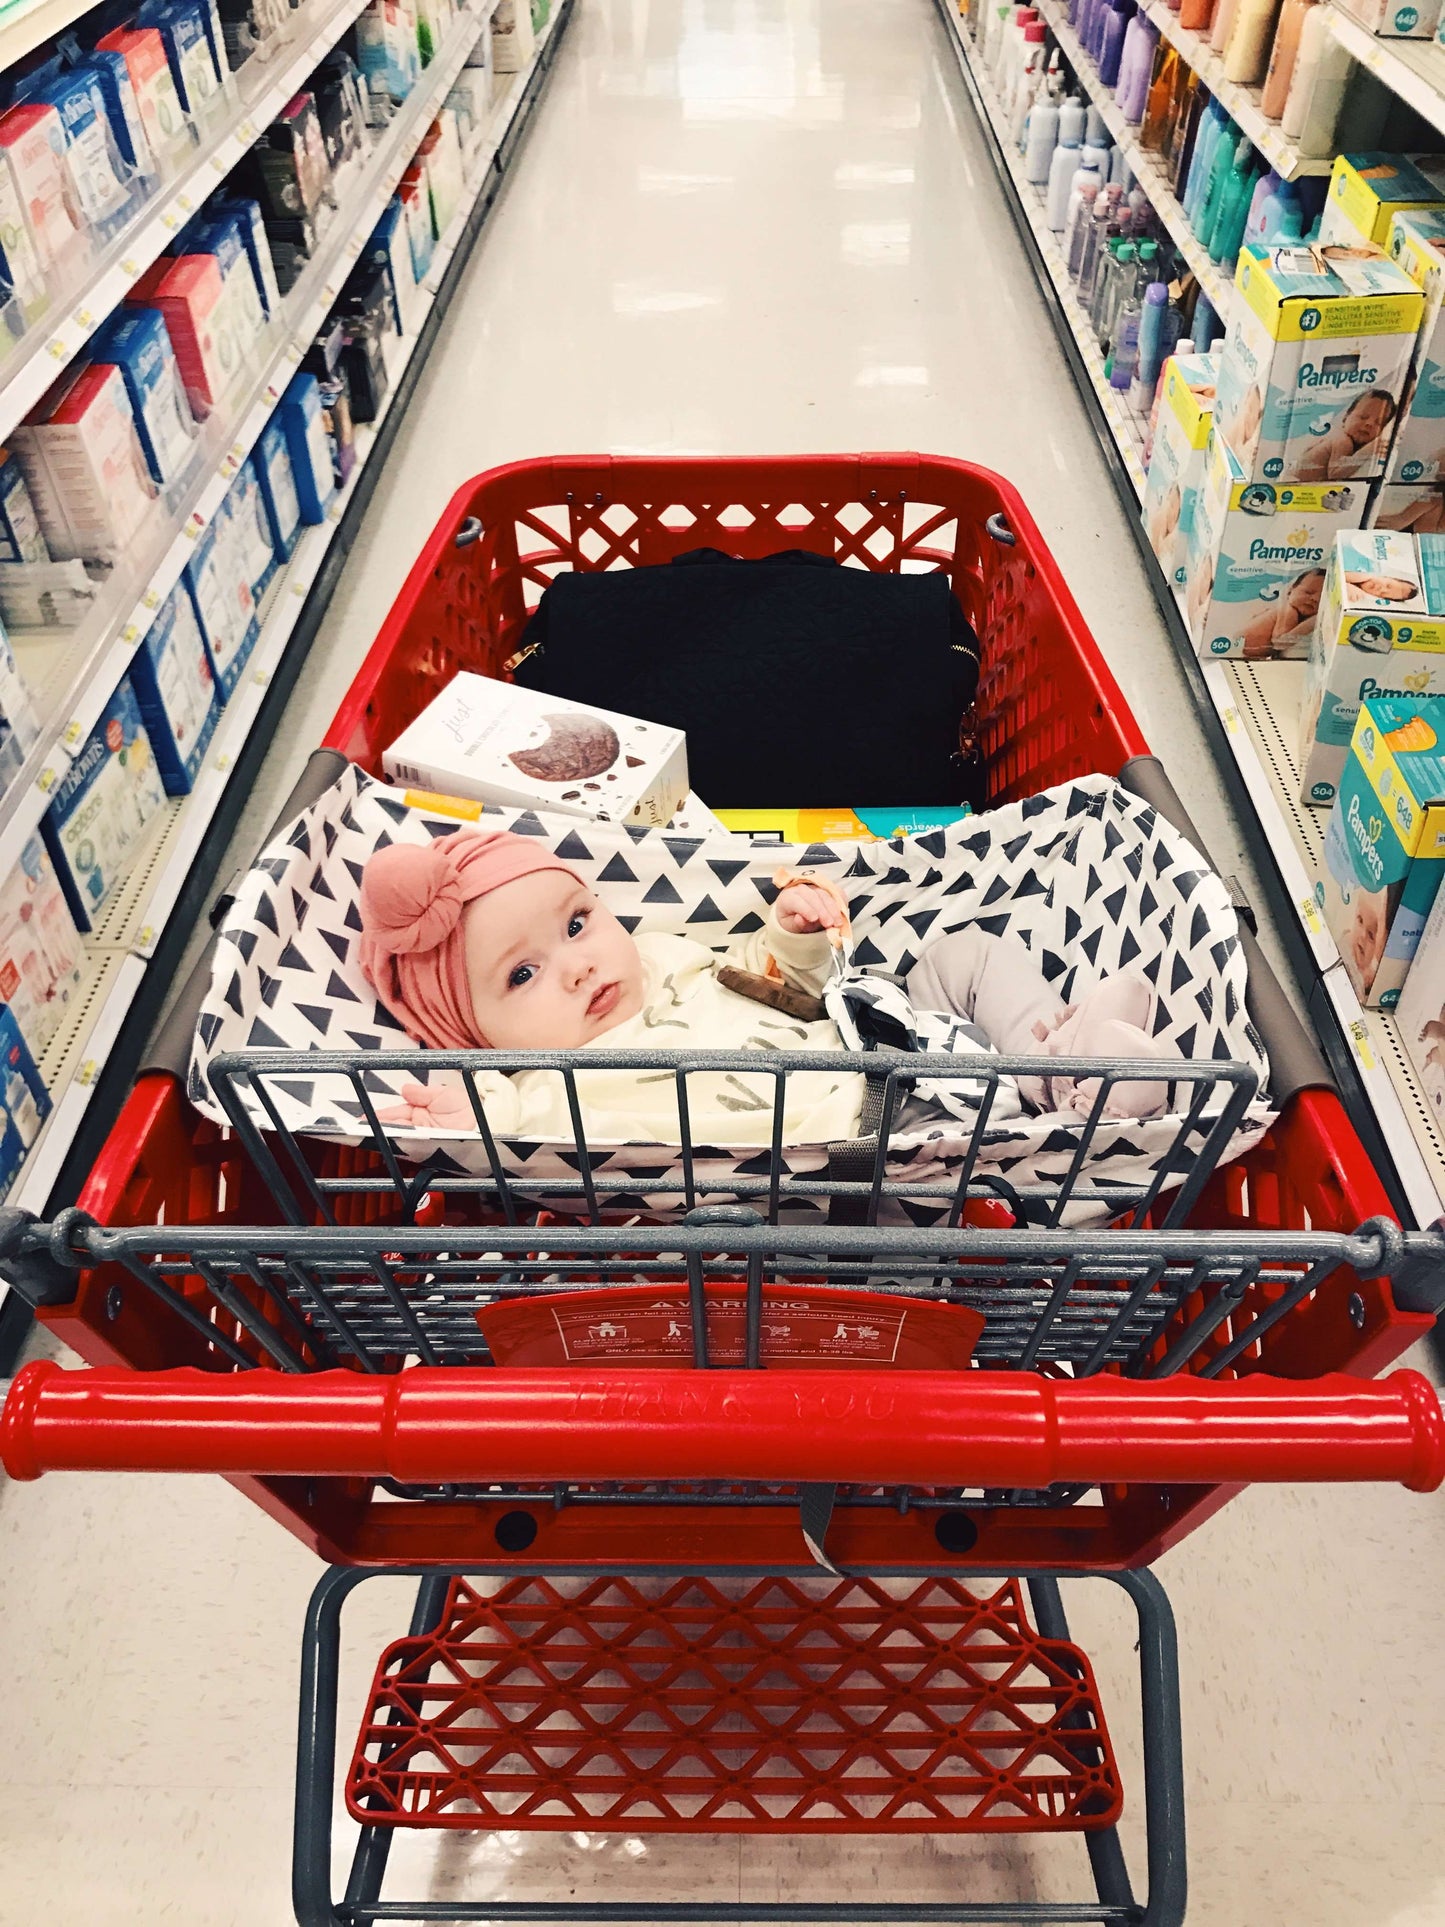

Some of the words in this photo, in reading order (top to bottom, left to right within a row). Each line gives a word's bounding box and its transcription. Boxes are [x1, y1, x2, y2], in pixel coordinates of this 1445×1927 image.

[1302, 311, 1317, 328] #1
[1297, 363, 1378, 389] Pampers
[1403, 466, 1422, 475] 504
[1280, 490, 1294, 505] 9
[1249, 538, 1324, 562] Pampers
[1397, 627, 1413, 643] 9
[1212, 642, 1229, 650] 504
[1312, 787, 1333, 796] 504
[1396, 796, 1413, 830] 648
[1348, 794, 1384, 881] Pampers
[567, 1381, 752, 1417] THANK
[786, 1382, 900, 1420] YOU
